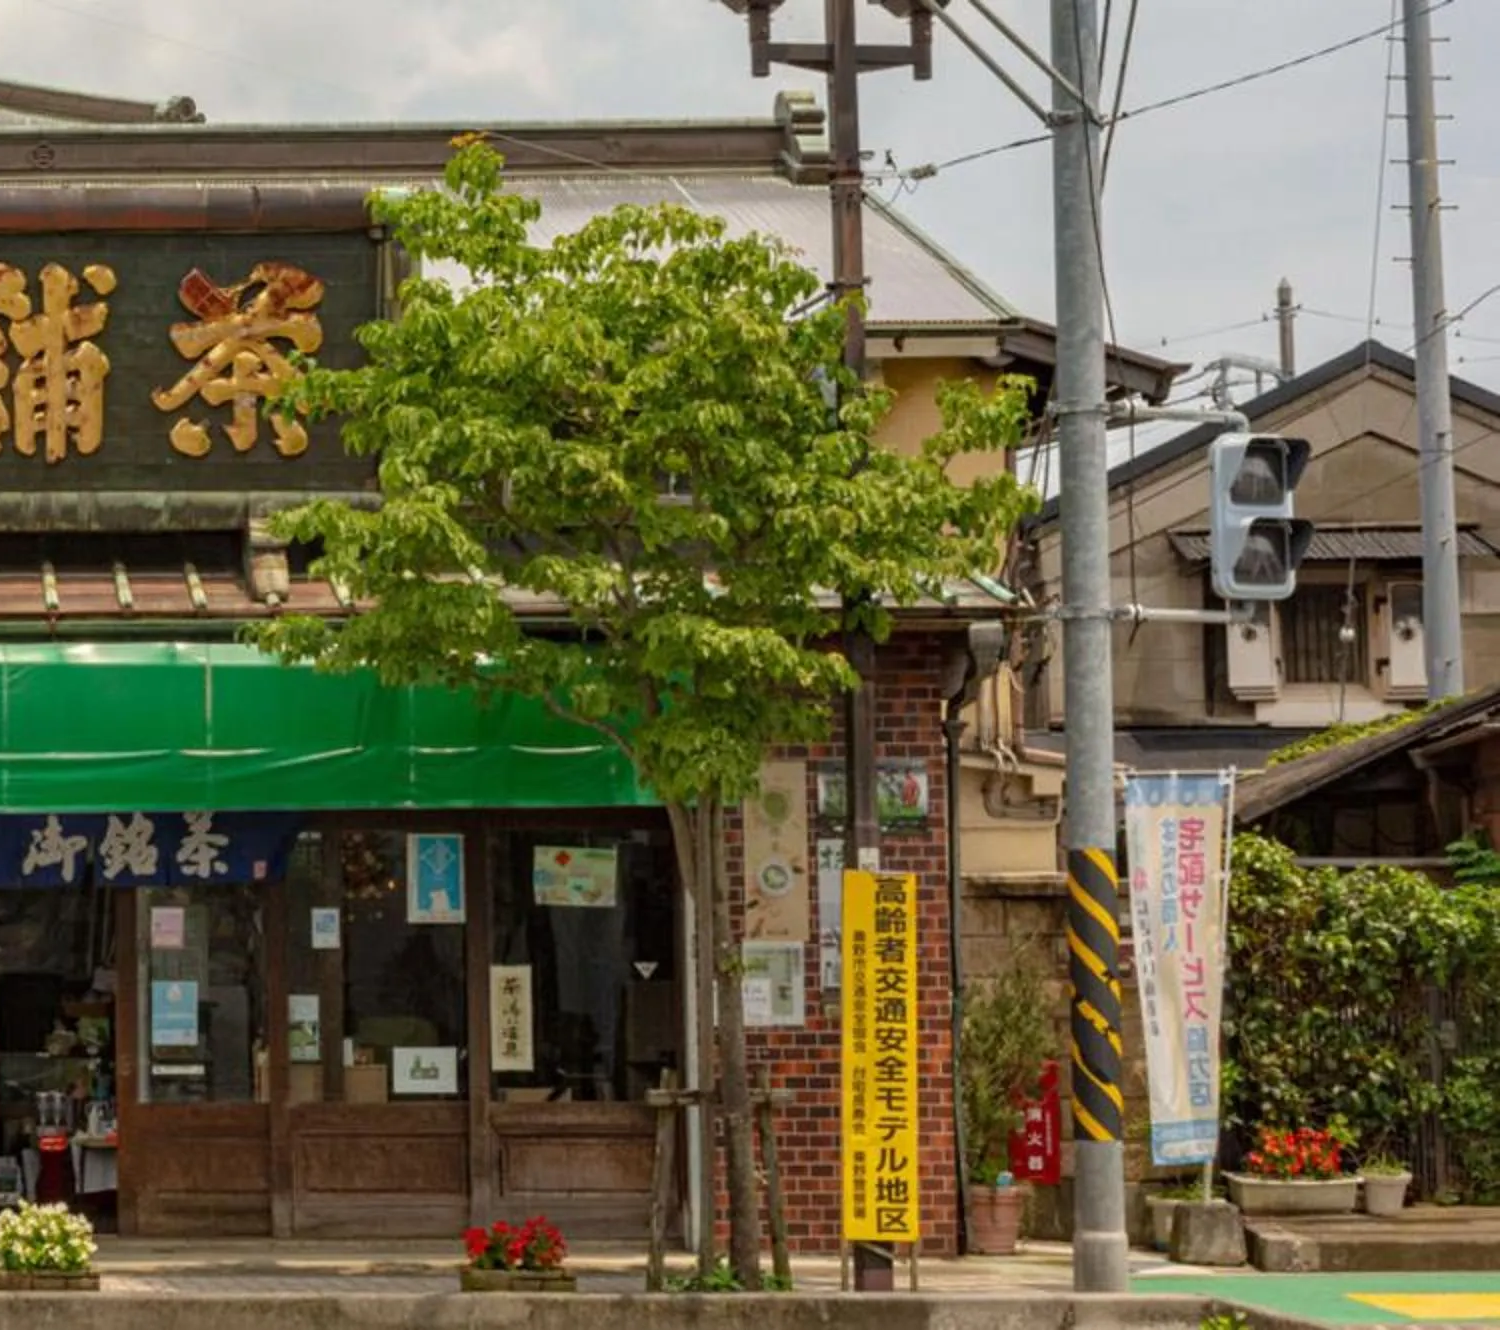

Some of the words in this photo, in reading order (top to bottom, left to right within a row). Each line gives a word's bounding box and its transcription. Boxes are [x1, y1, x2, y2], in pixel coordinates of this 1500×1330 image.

[22, 811, 229, 882] 御銘茶
[873, 877, 909, 1233] 高齢者交通安全モデル地区
[1027, 1107, 1043, 1170] 消火器
